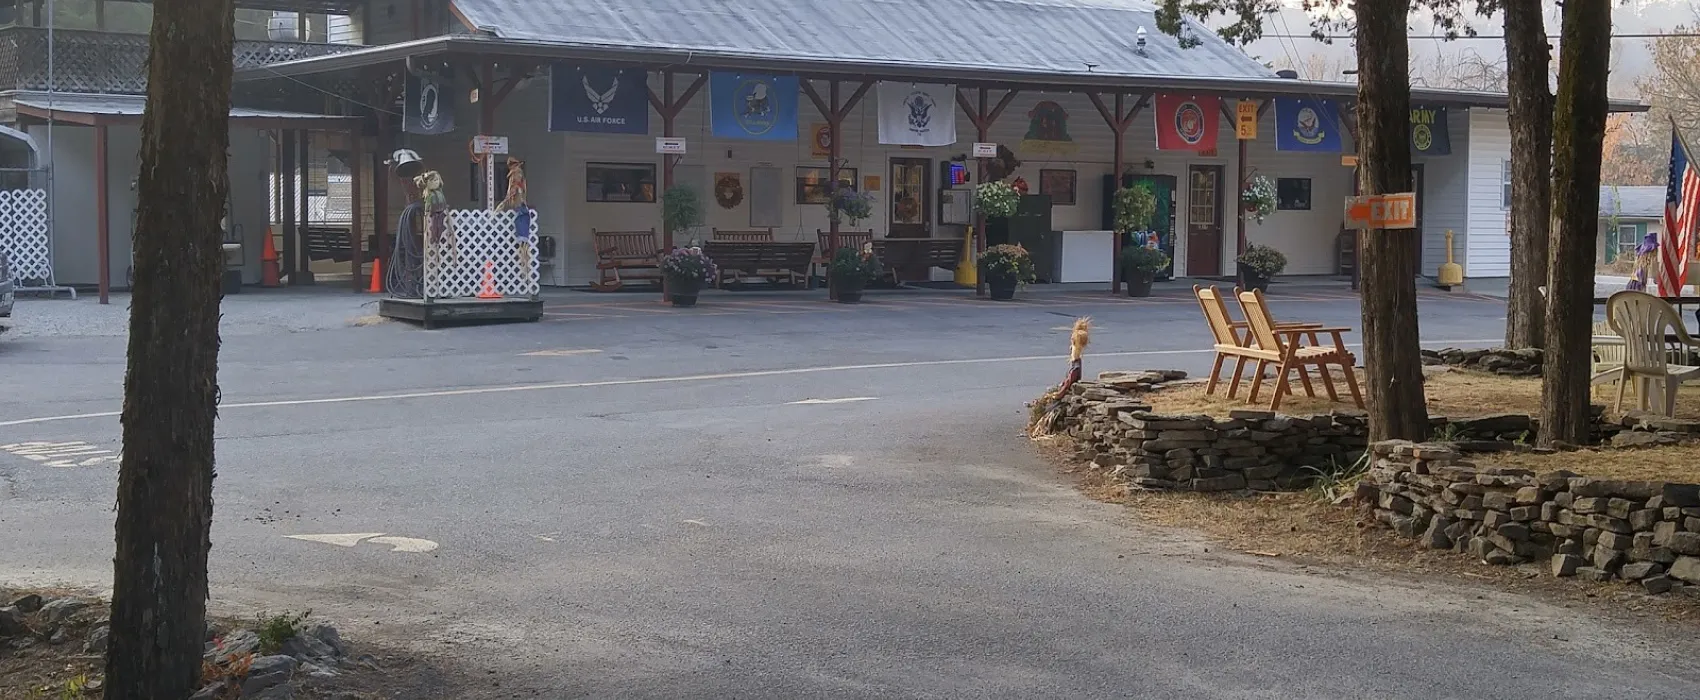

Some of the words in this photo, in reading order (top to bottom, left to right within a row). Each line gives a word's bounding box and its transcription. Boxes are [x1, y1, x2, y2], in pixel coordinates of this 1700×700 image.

[1238, 104, 1254, 113] EXIT
[602, 117, 626, 125] FORCE
[1240, 124, 1247, 136] 5
[1371, 200, 1410, 221] EXIT
